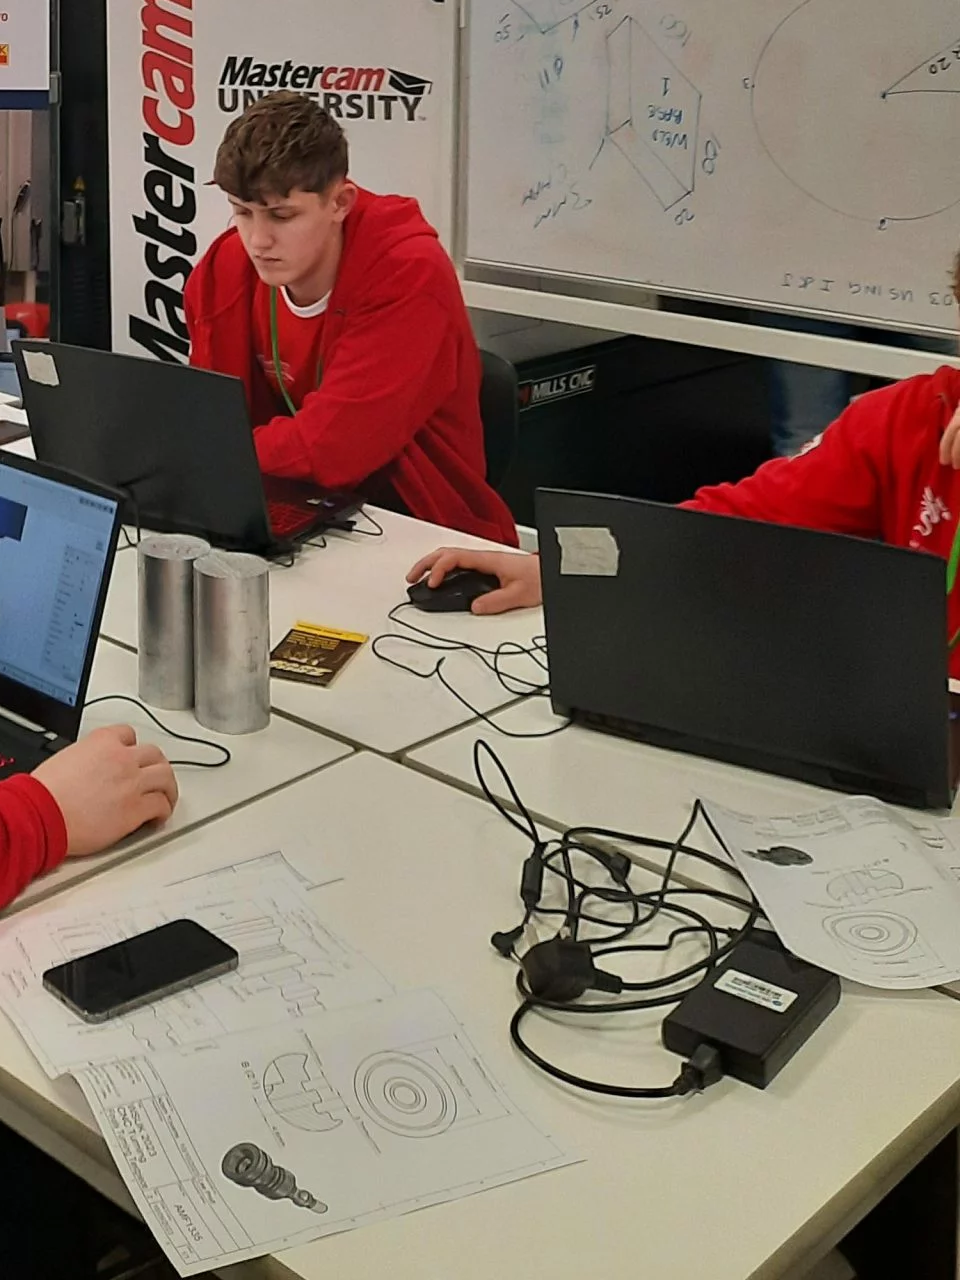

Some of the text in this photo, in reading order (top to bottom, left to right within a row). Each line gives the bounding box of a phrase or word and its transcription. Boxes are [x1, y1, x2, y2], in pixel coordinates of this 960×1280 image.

[219, 56, 386, 92] Mastercam
[532, 369, 595, 401] MILLS CNC
[141, 1133, 158, 1157] 2023
